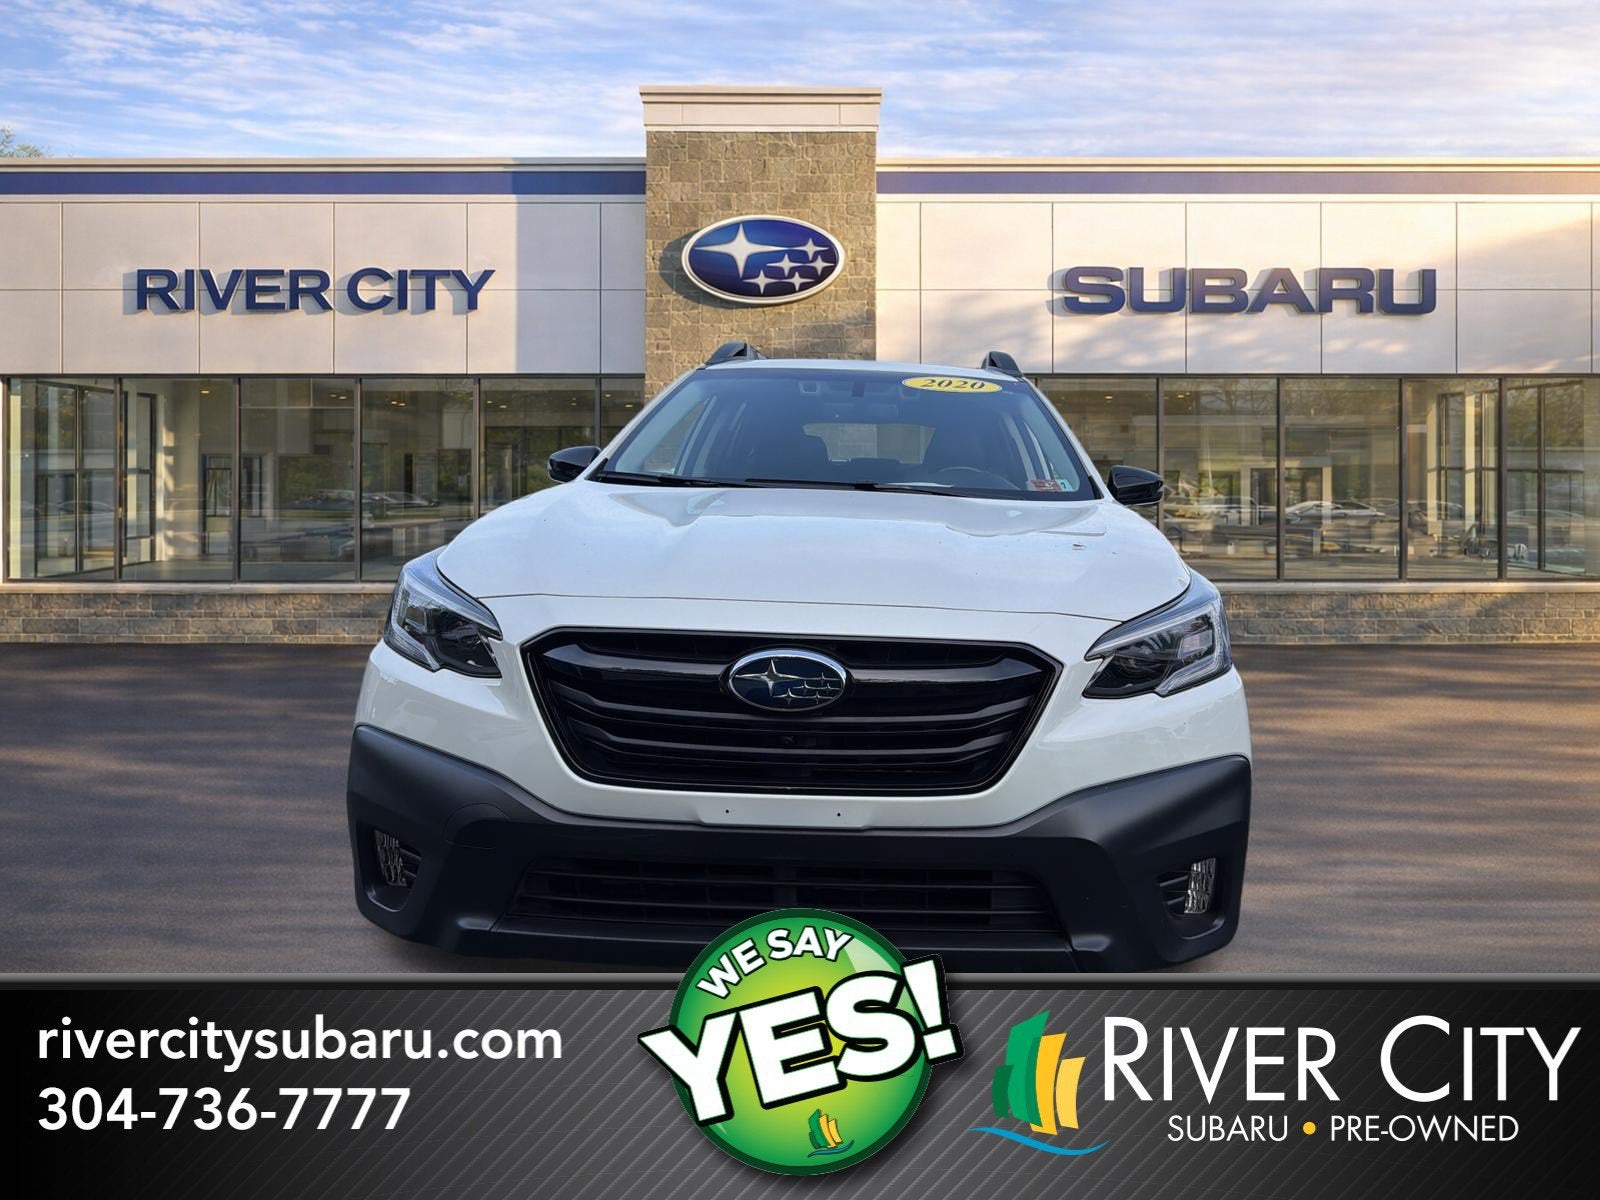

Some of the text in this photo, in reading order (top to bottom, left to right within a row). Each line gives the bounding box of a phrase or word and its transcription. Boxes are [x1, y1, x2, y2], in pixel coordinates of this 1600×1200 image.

[136, 267, 496, 311] RIVER CITY
[1063, 266, 1437, 315] SUBARU
[921, 378, 985, 390] 2020
